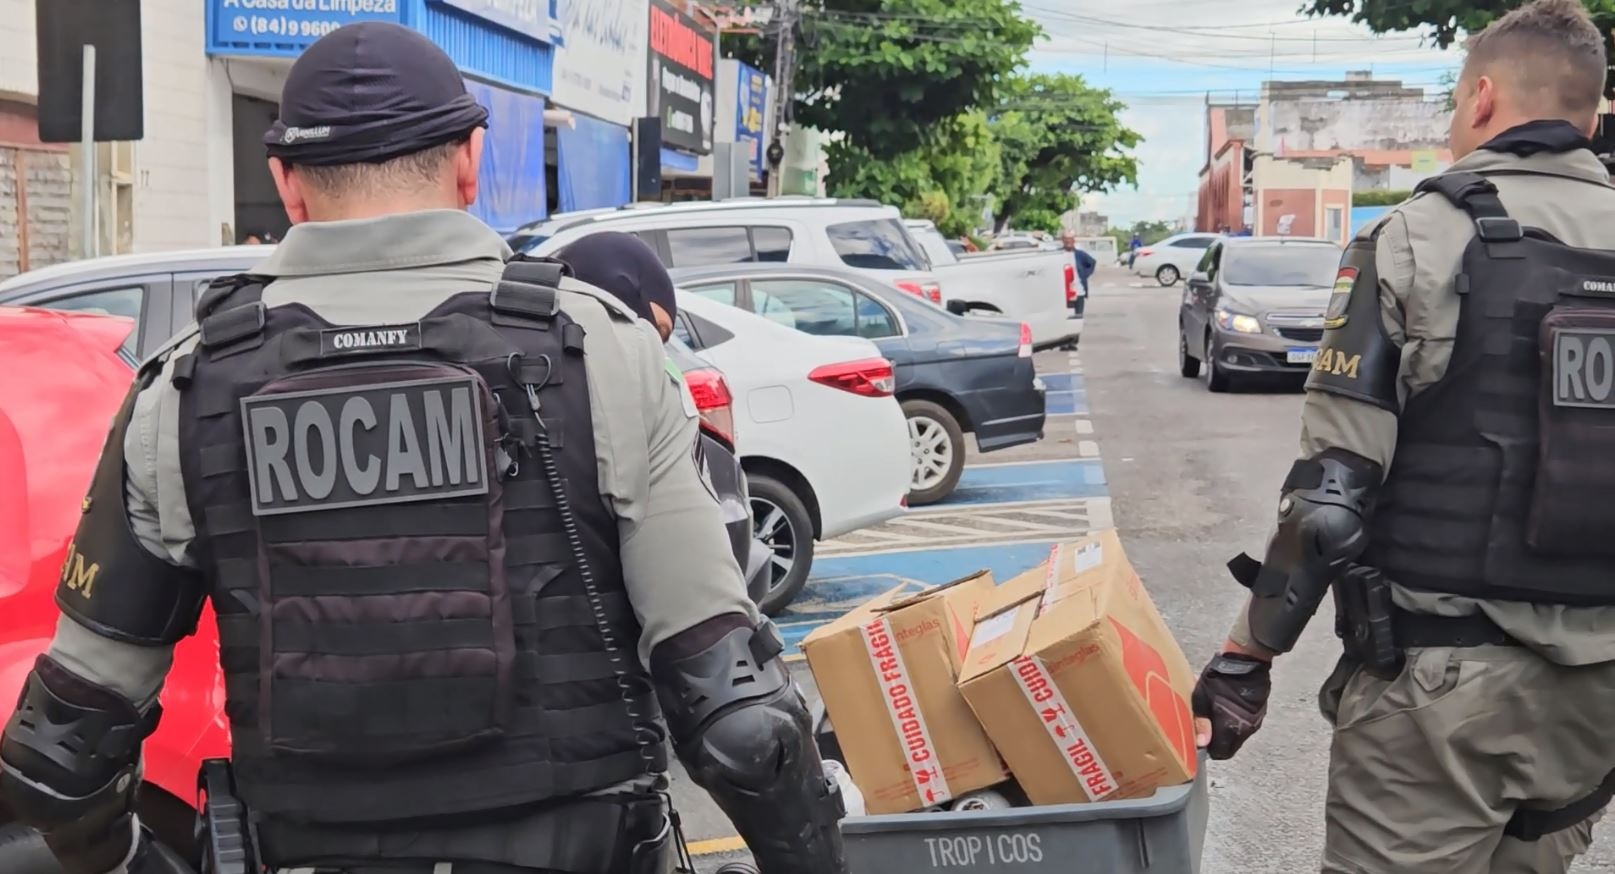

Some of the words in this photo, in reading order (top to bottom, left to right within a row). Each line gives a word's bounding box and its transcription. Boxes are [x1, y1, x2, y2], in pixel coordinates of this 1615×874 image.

[333, 330, 407, 348] COMANFY
[250, 387, 478, 503] ROCAM
[889, 684, 931, 763] CUIDADO
[1067, 738, 1112, 795] FRÁGIL
